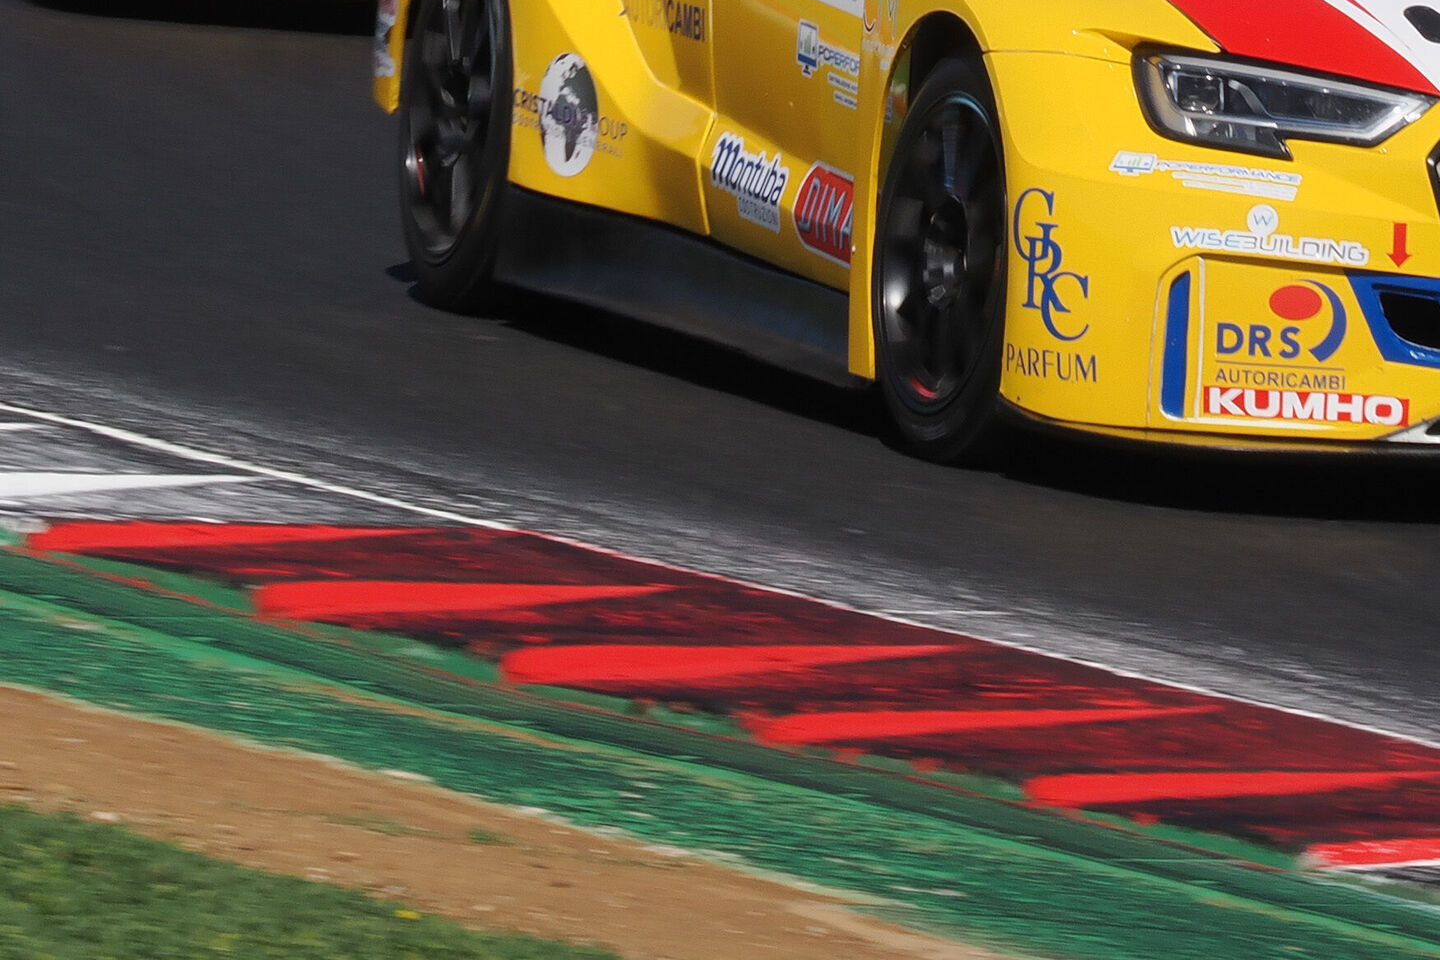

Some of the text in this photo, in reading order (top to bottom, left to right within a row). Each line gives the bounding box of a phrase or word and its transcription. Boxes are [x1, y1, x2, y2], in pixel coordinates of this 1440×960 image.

[1173, 229, 1366, 262] WISEBUILDING
[1216, 322, 1301, 359] DRS
[1006, 342, 1097, 383] PARFUM
[1215, 367, 1346, 391] AUTORICAMBI
[1208, 387, 1404, 426] KUMHO
